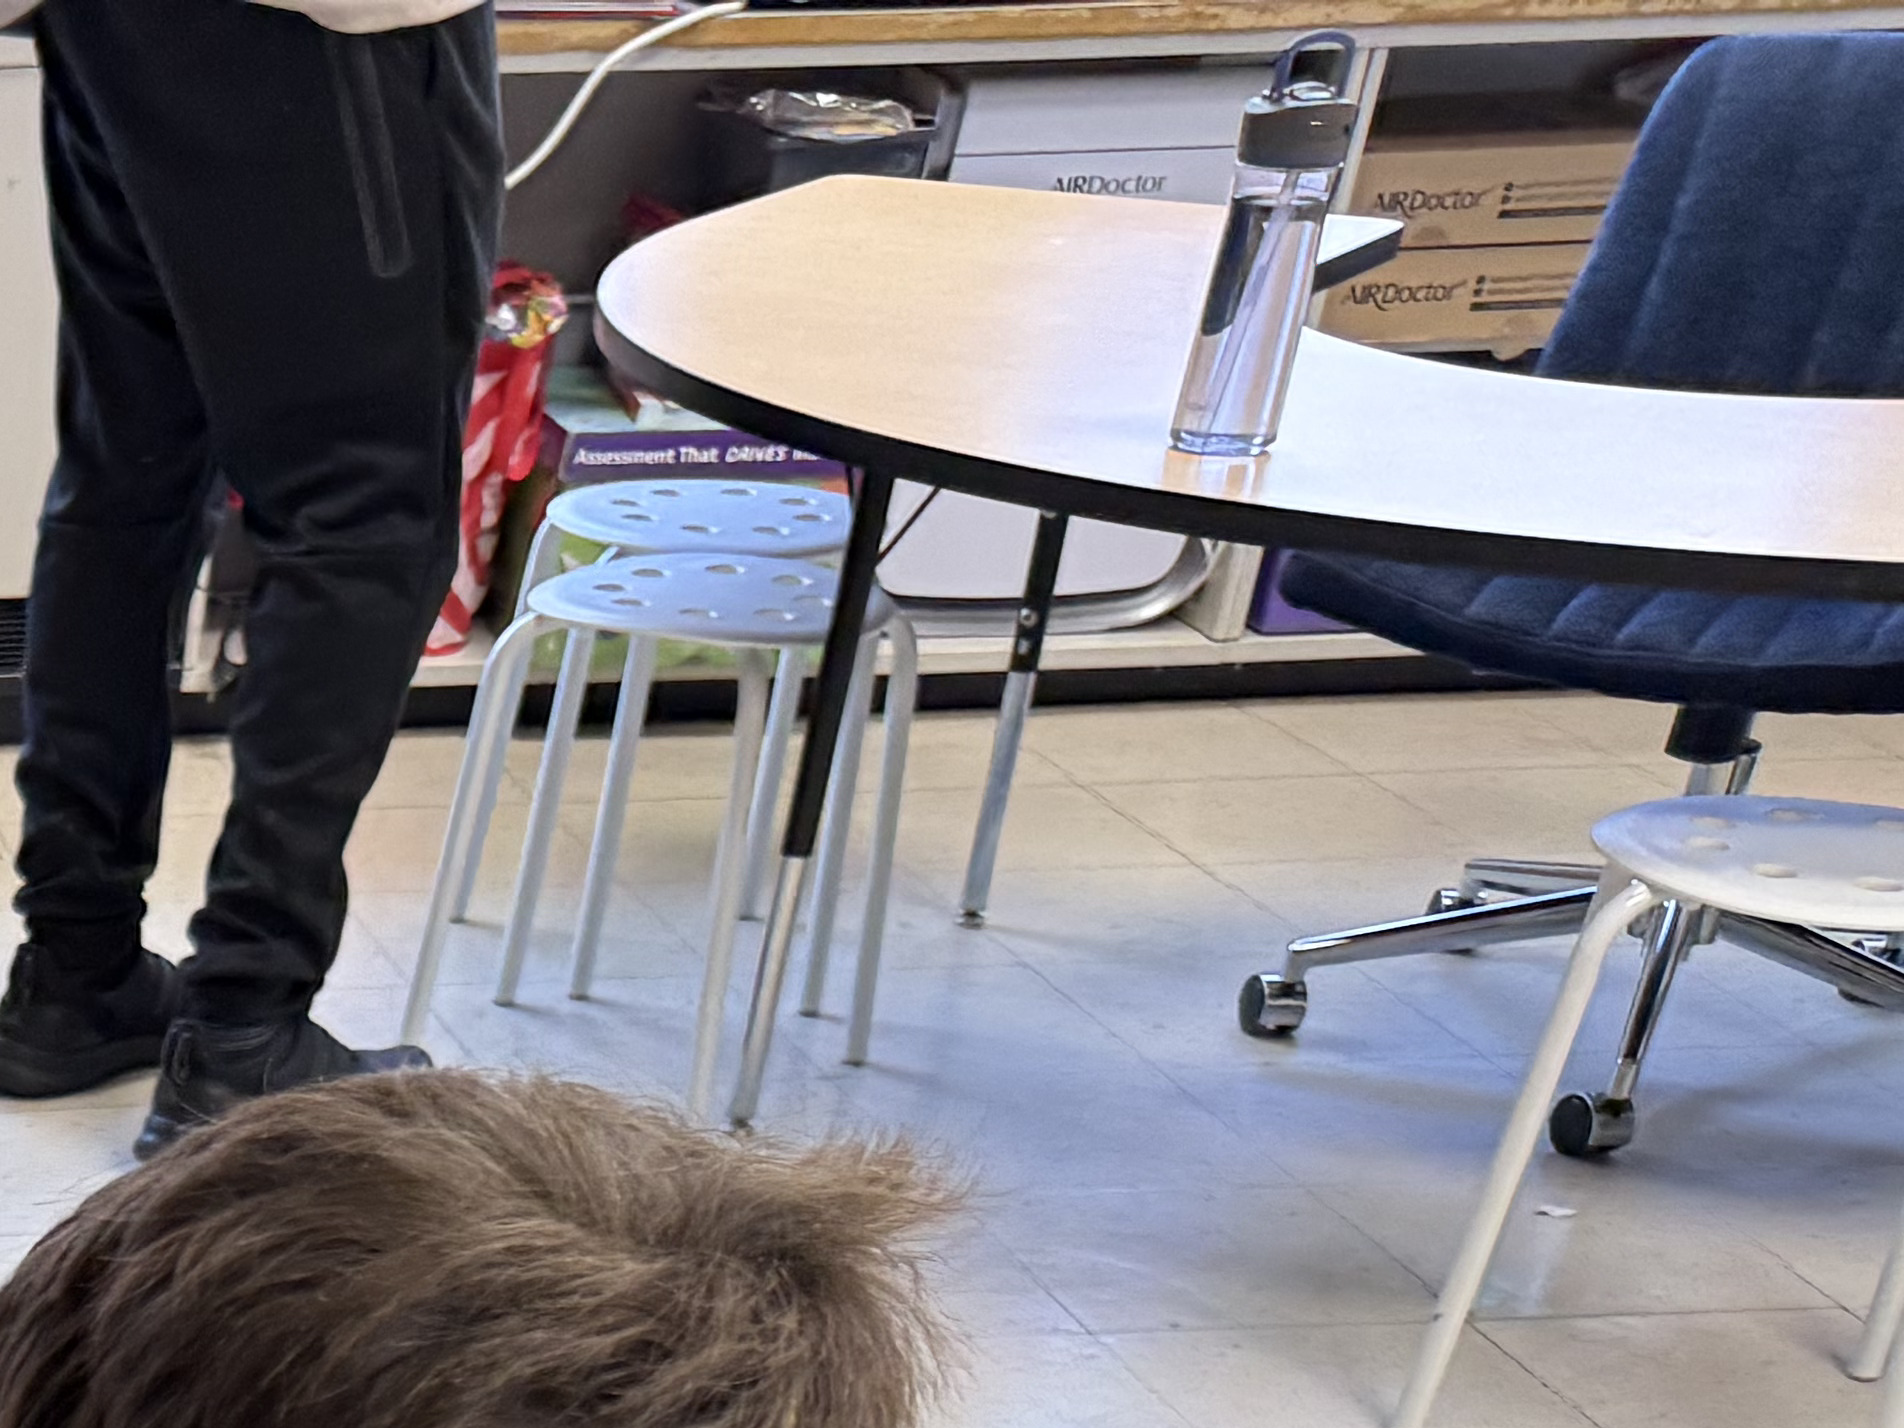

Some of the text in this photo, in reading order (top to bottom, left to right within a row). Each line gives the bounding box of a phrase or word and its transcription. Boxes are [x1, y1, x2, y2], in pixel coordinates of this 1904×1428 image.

[573, 447, 677, 466] Assessment
[679, 445, 720, 464] That
[724, 444, 789, 463] DRIVES
